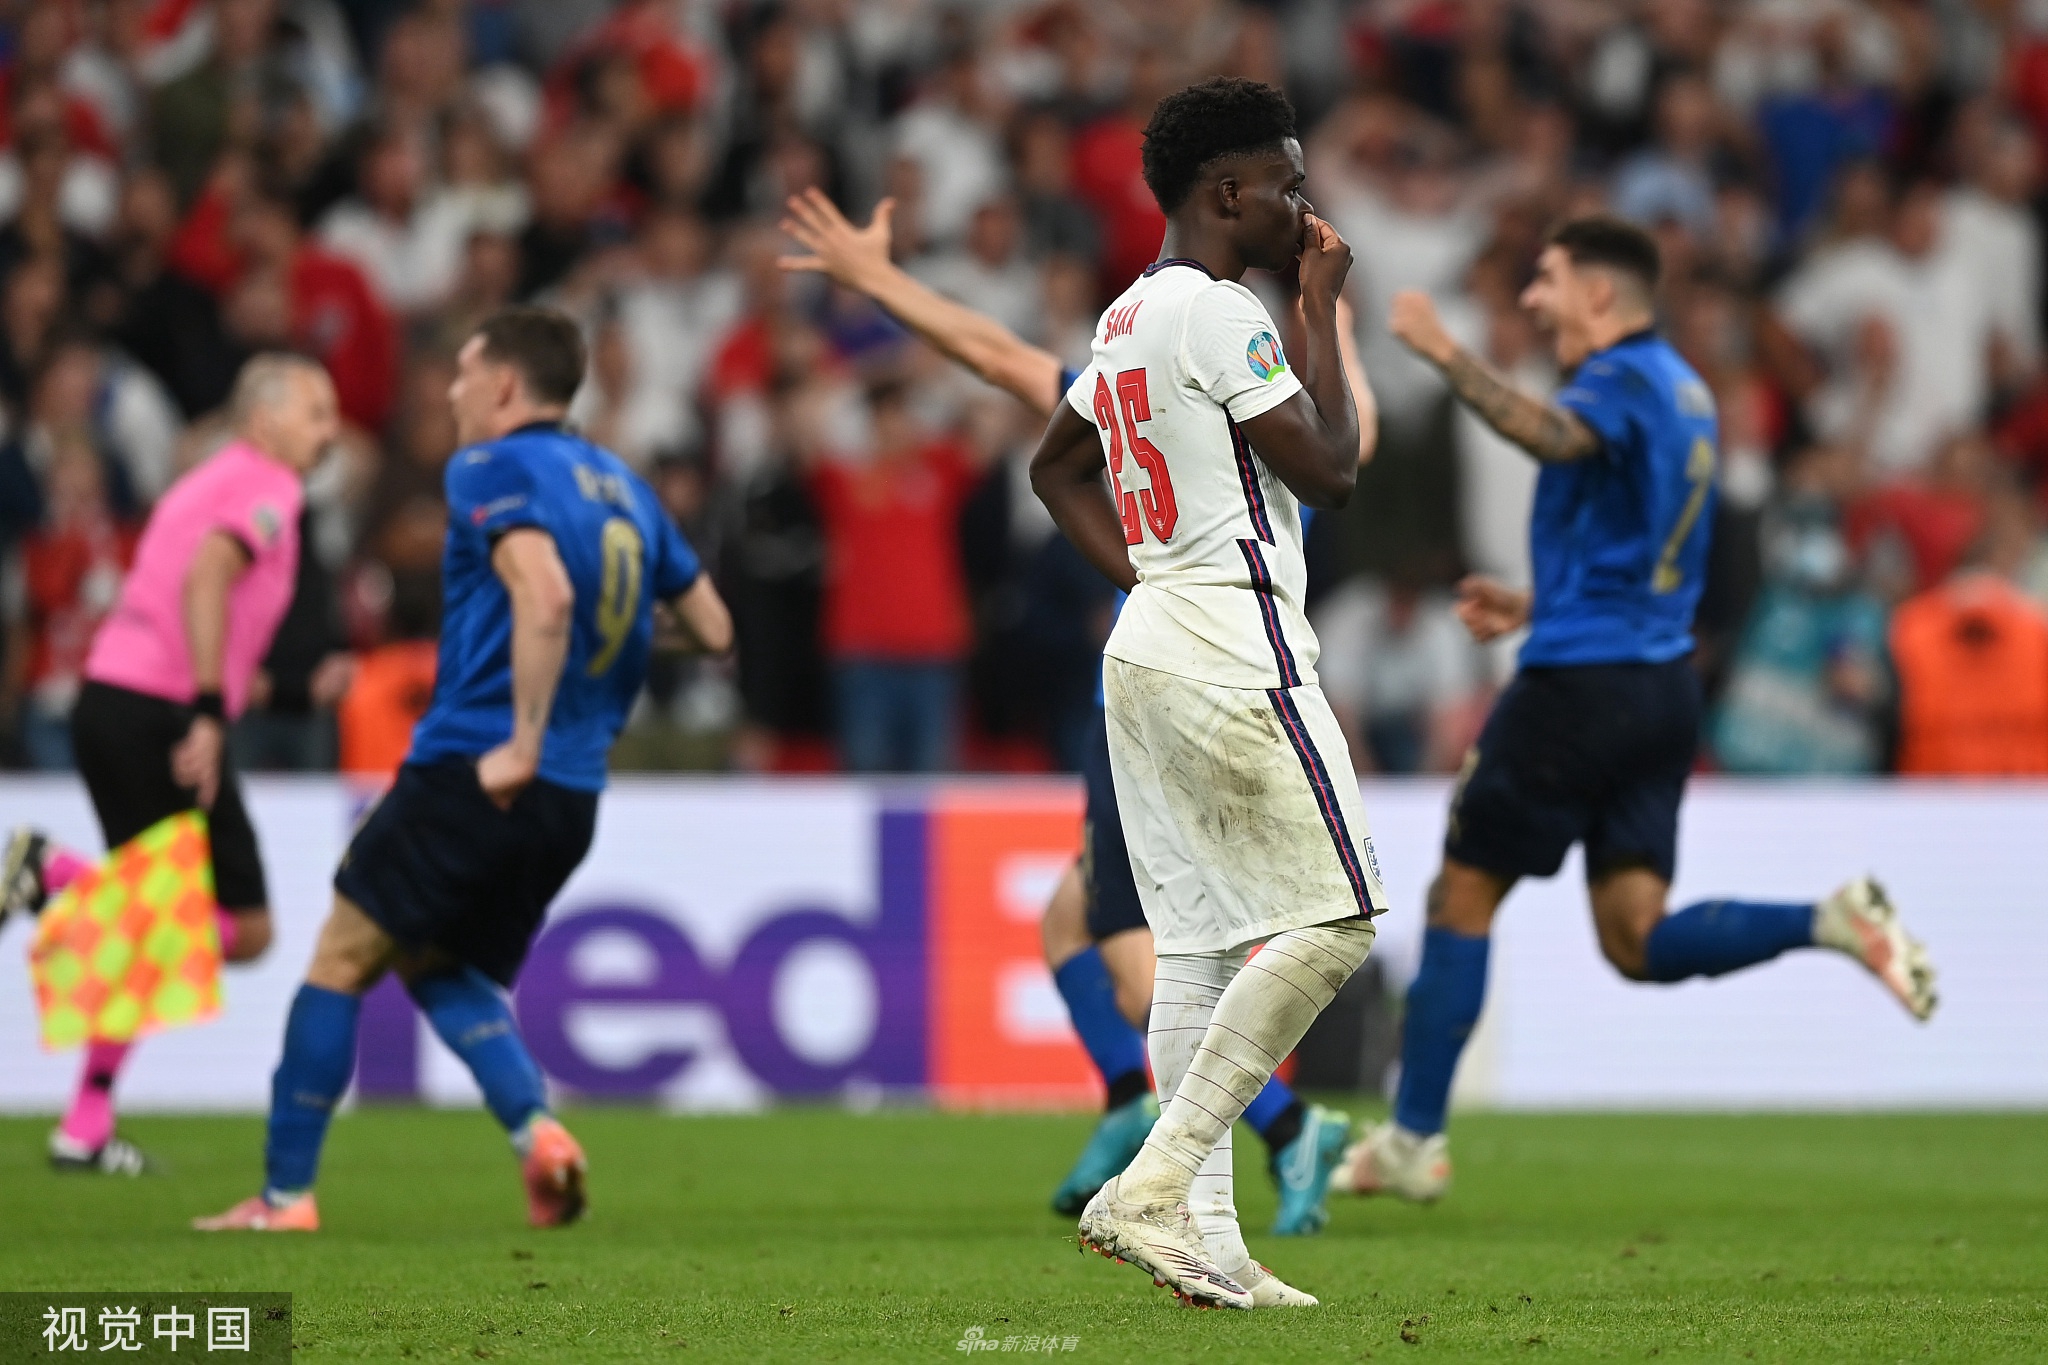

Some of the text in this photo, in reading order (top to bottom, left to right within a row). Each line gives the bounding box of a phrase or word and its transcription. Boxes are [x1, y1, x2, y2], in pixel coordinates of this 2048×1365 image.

[1104, 299, 1143, 345] SAKA
[1093, 367, 1179, 545] 25
[585, 515, 644, 677] 9
[348, 797, 1160, 1098] edE
